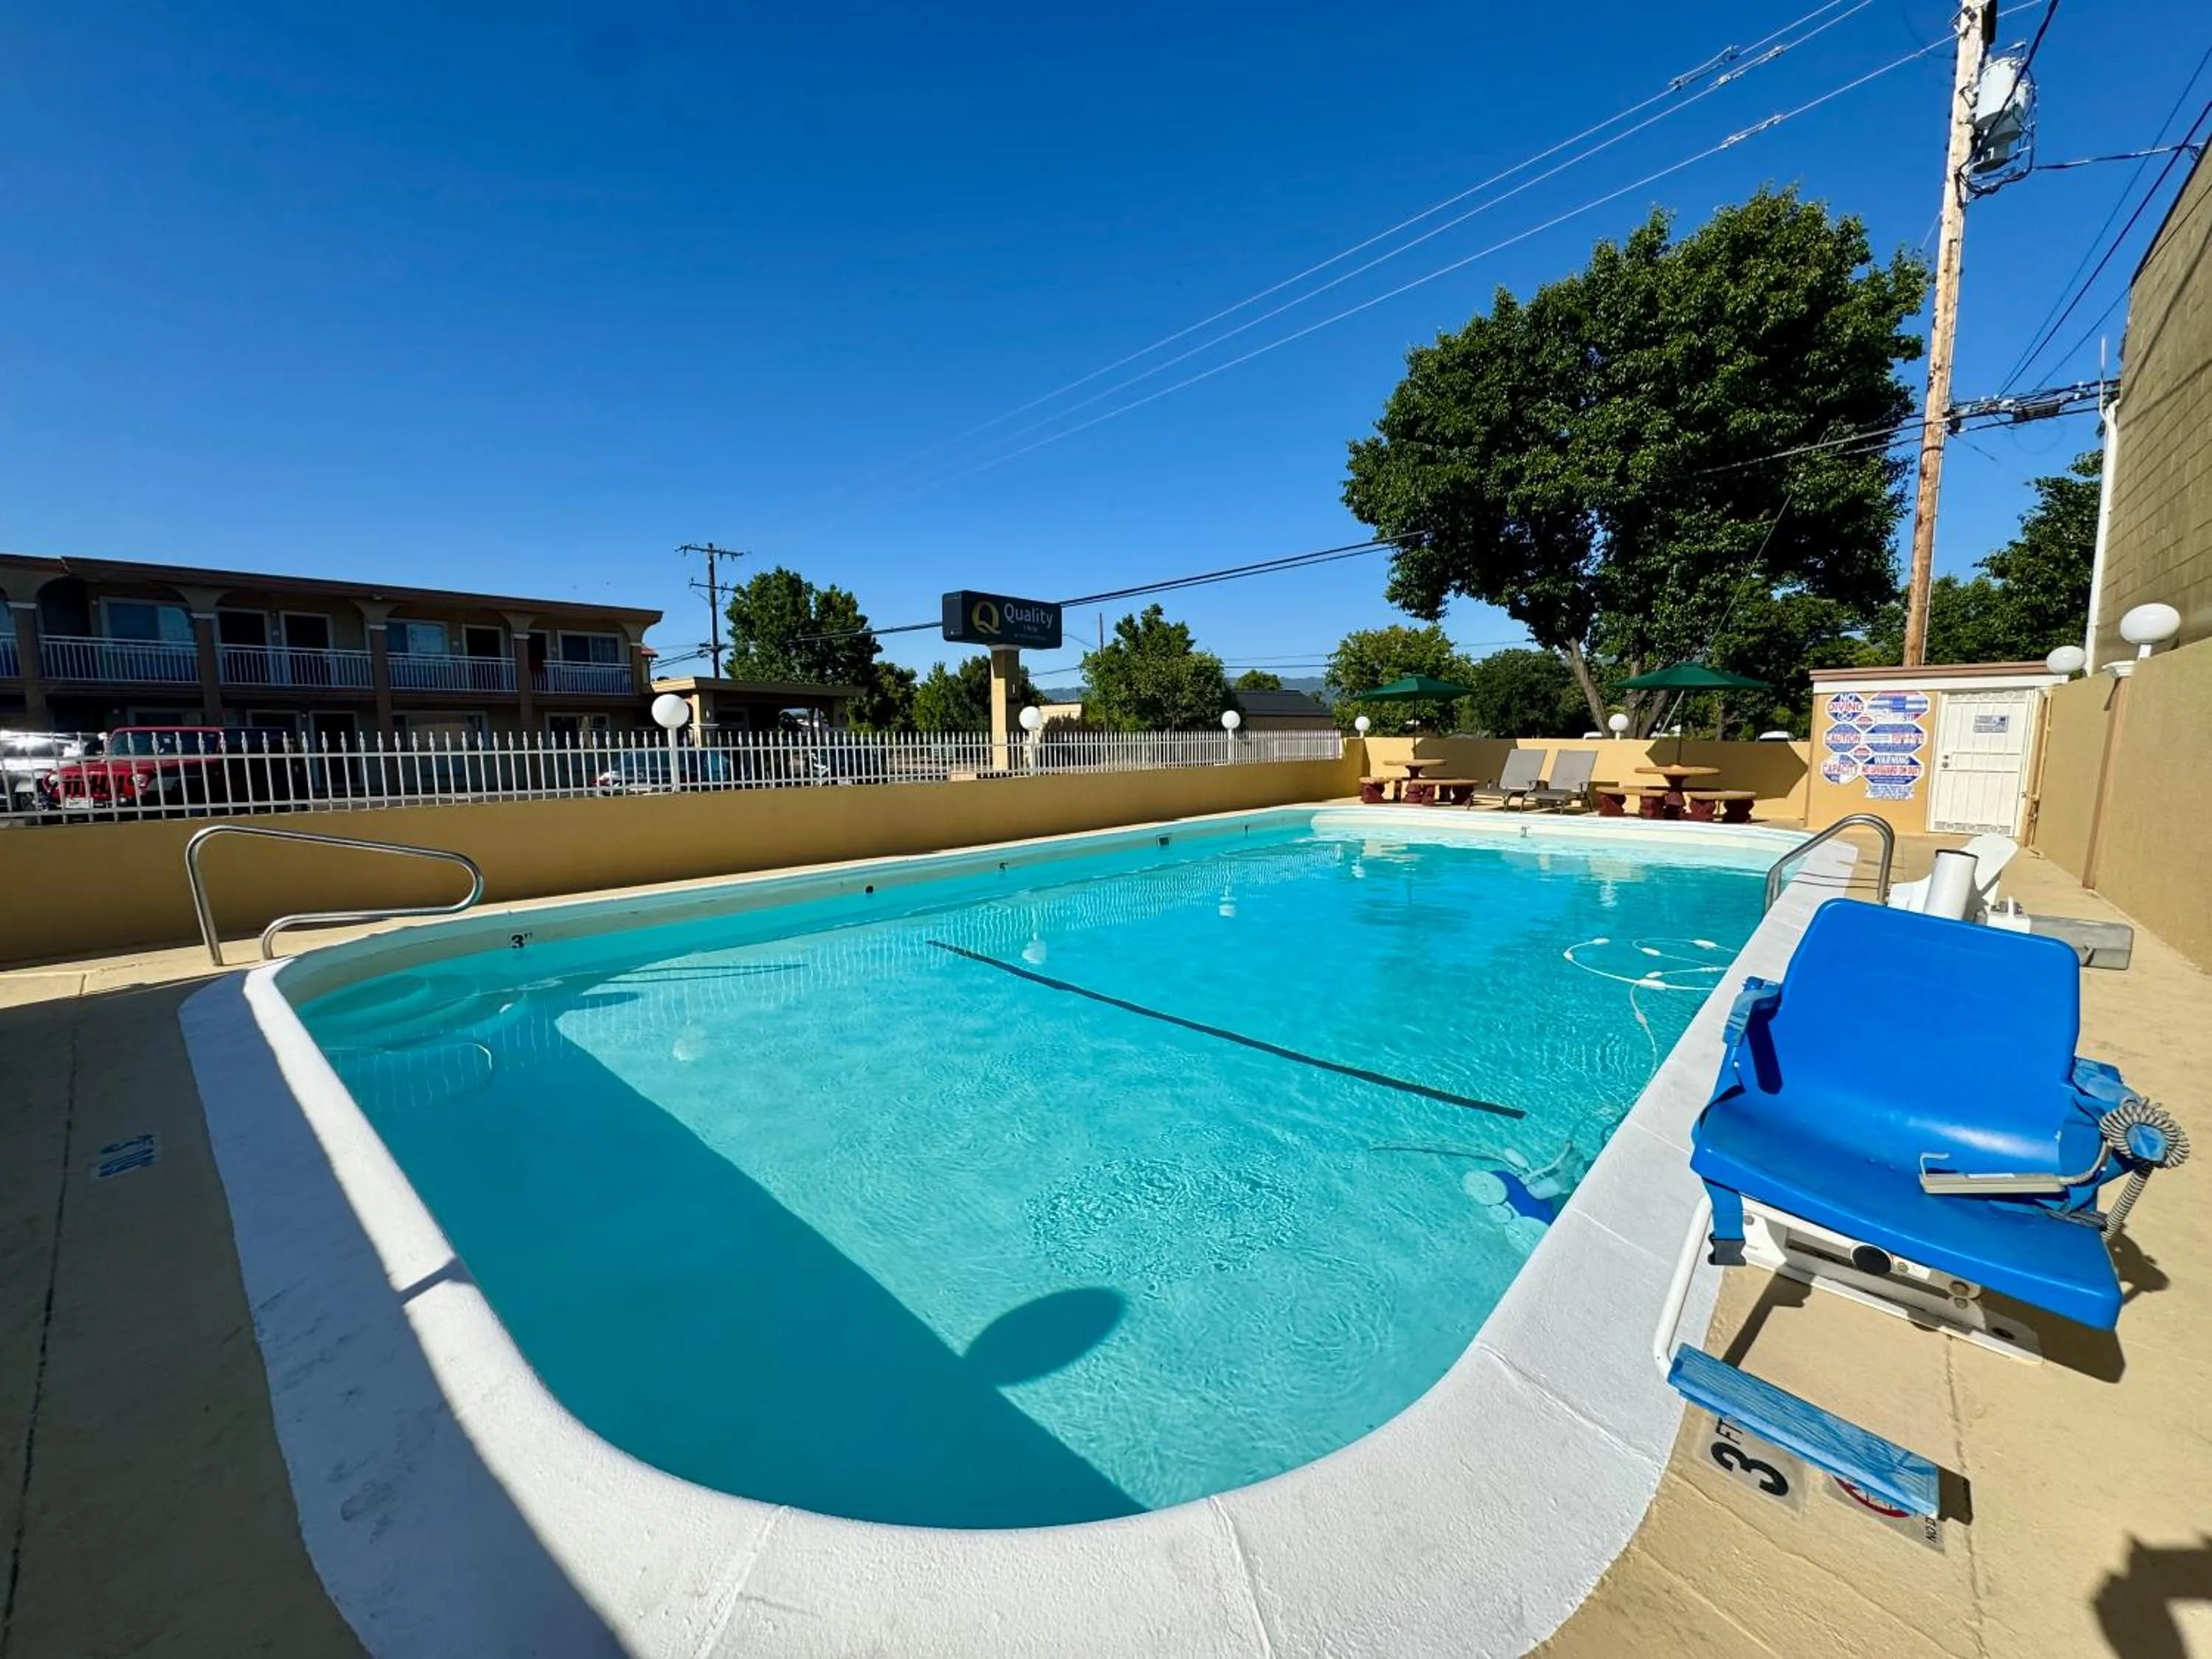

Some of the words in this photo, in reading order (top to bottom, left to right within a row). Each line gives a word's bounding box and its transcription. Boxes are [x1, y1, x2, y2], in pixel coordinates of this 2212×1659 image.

[971, 600, 1001, 635] Q
[1004, 603, 1054, 628] Quality
[1827, 702, 1865, 712] DIVING
[1839, 693, 1856, 702] NO
[1716, 1416, 1743, 1445] FT
[1710, 1441, 1789, 1497] 3
